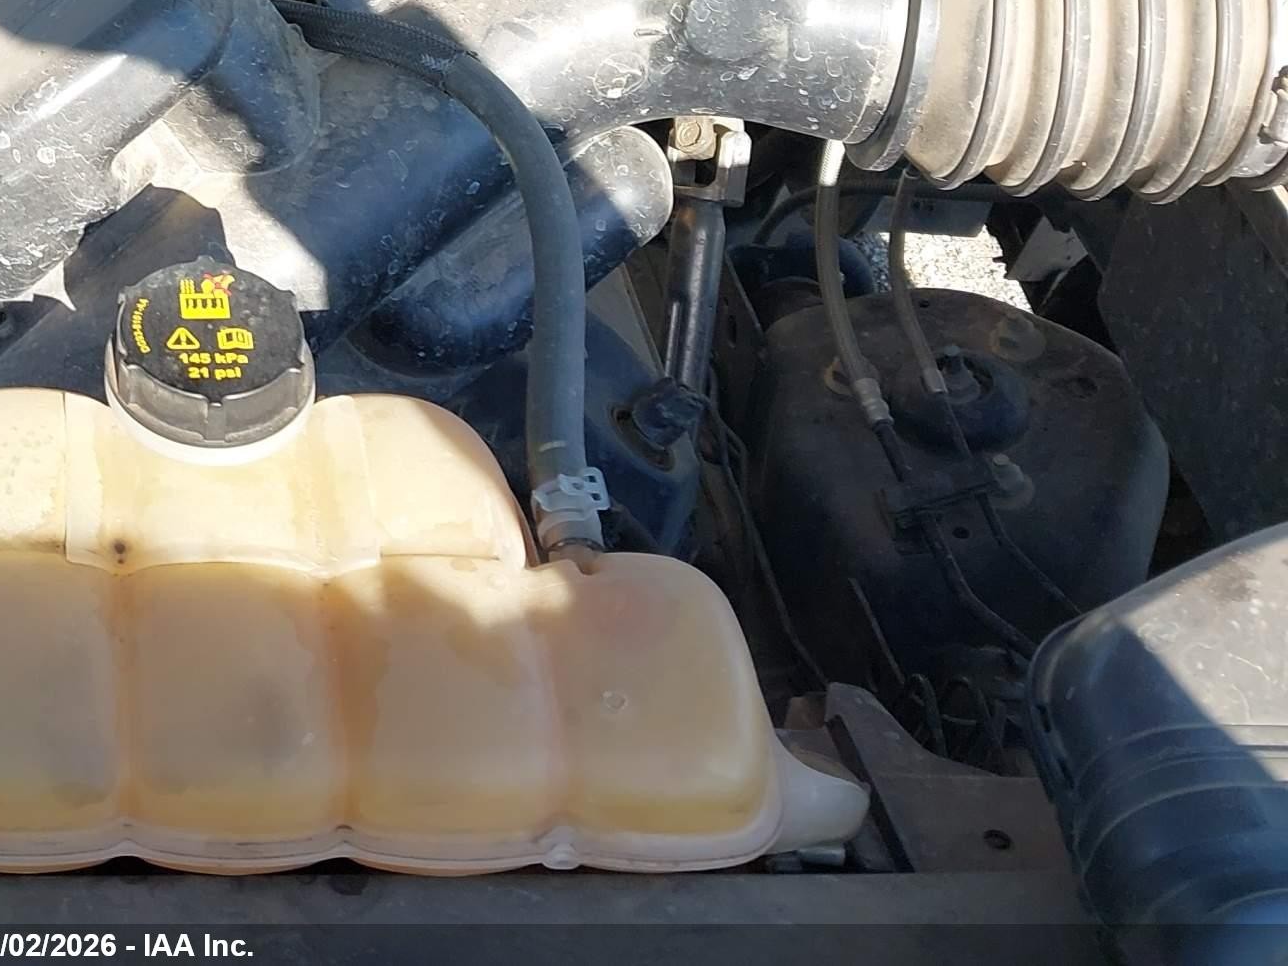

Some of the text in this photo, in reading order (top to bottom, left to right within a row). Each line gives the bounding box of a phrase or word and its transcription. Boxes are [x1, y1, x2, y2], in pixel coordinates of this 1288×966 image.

[178, 352, 249, 364] 145 kPa
[187, 366, 242, 381] 21 psi
